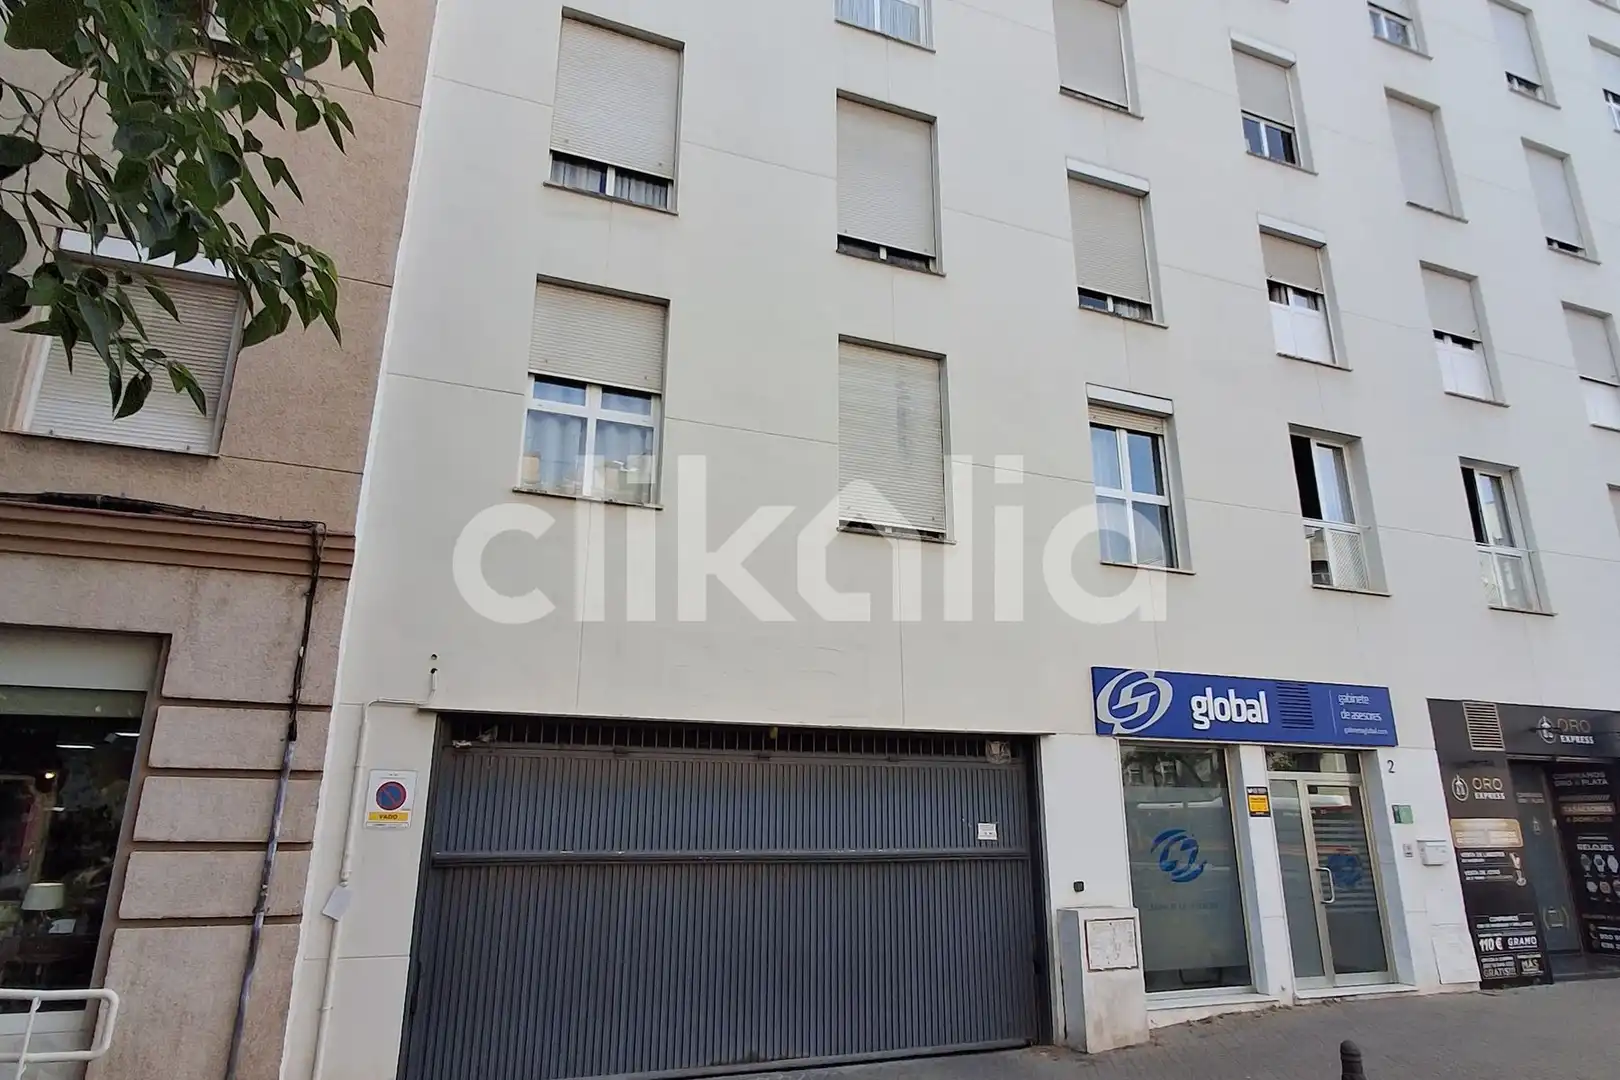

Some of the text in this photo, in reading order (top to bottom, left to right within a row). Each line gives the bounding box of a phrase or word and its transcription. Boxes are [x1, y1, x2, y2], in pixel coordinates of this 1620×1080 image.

[1190, 686, 1269, 730] global
[1557, 718, 1591, 733] ORO
[1560, 734, 1594, 744] EXPRESS
[1387, 759, 1396, 774] 2
[1472, 777, 1503, 791] ORO
[1474, 792, 1506, 800] EXPRESS
[1507, 936, 1538, 946] GRAMO
